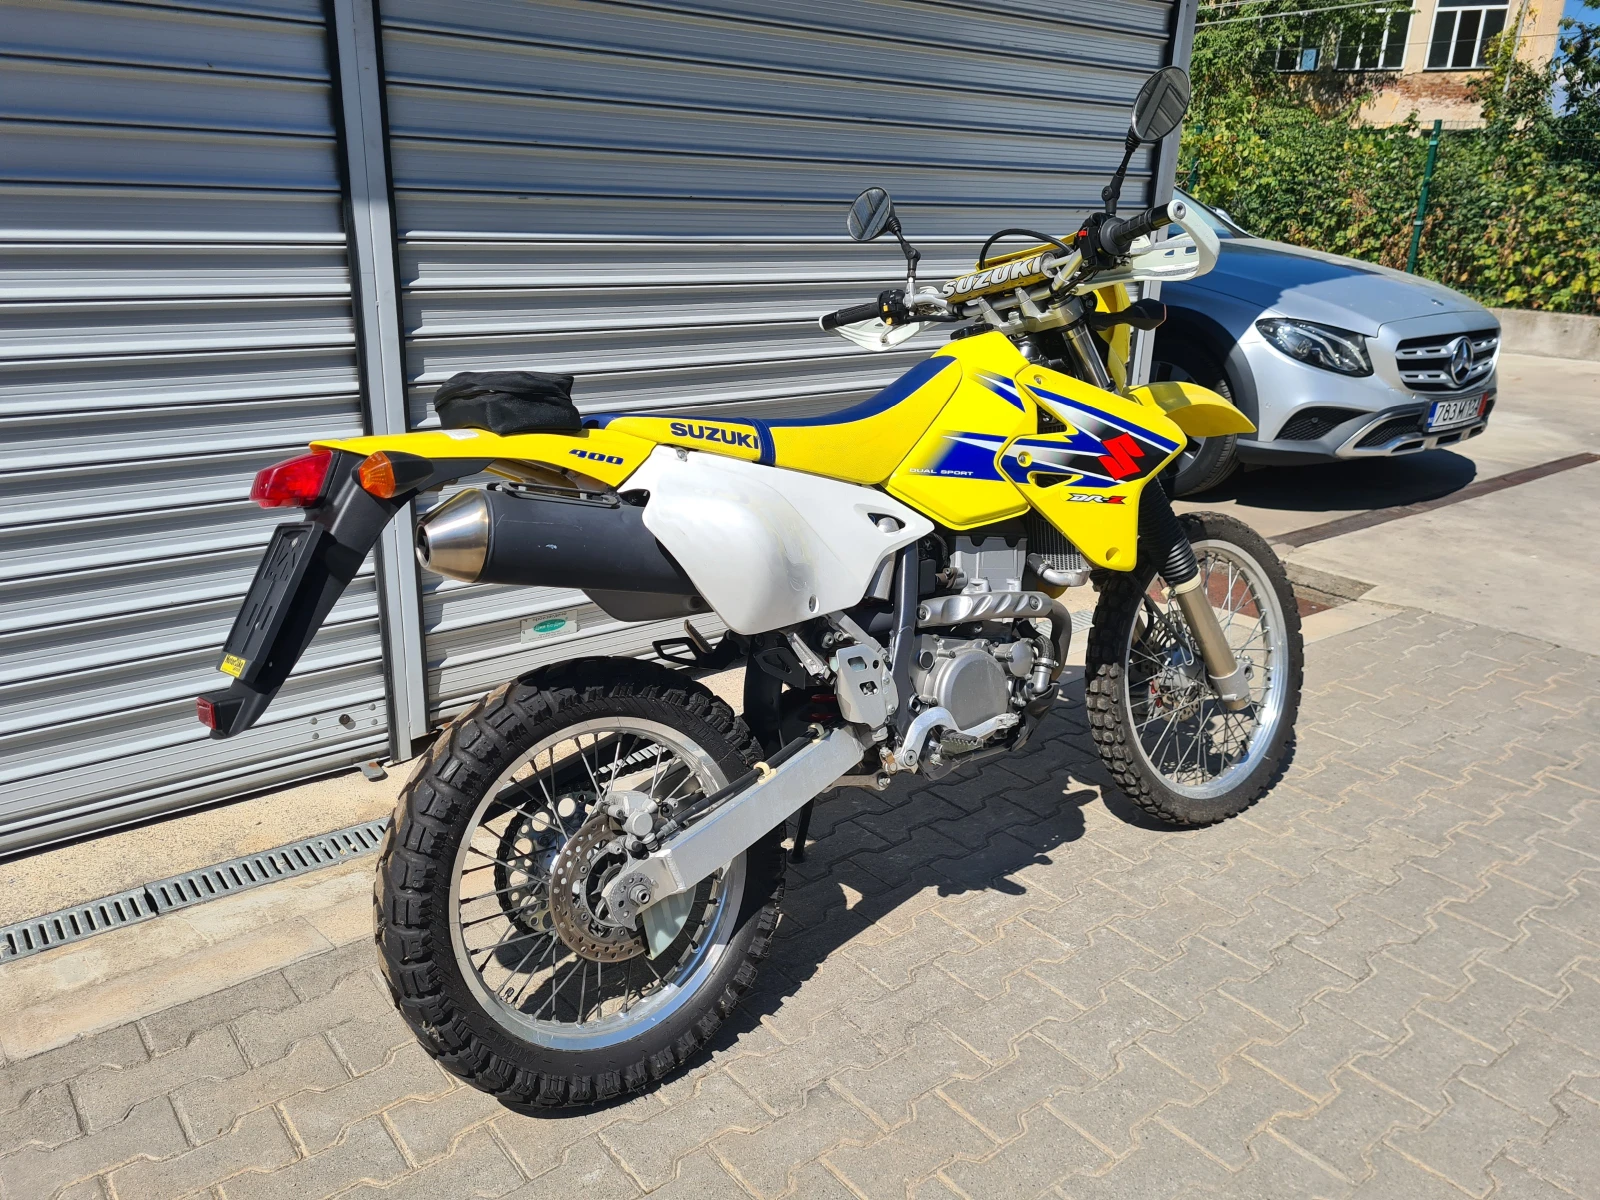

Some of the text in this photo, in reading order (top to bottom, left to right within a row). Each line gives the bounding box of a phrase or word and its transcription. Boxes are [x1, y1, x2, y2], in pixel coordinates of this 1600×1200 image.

[942, 256, 1041, 298] SUZUKI
[670, 422, 760, 450] SUZUKI
[568, 448, 625, 465] 400
[909, 467, 938, 475] DUAL
